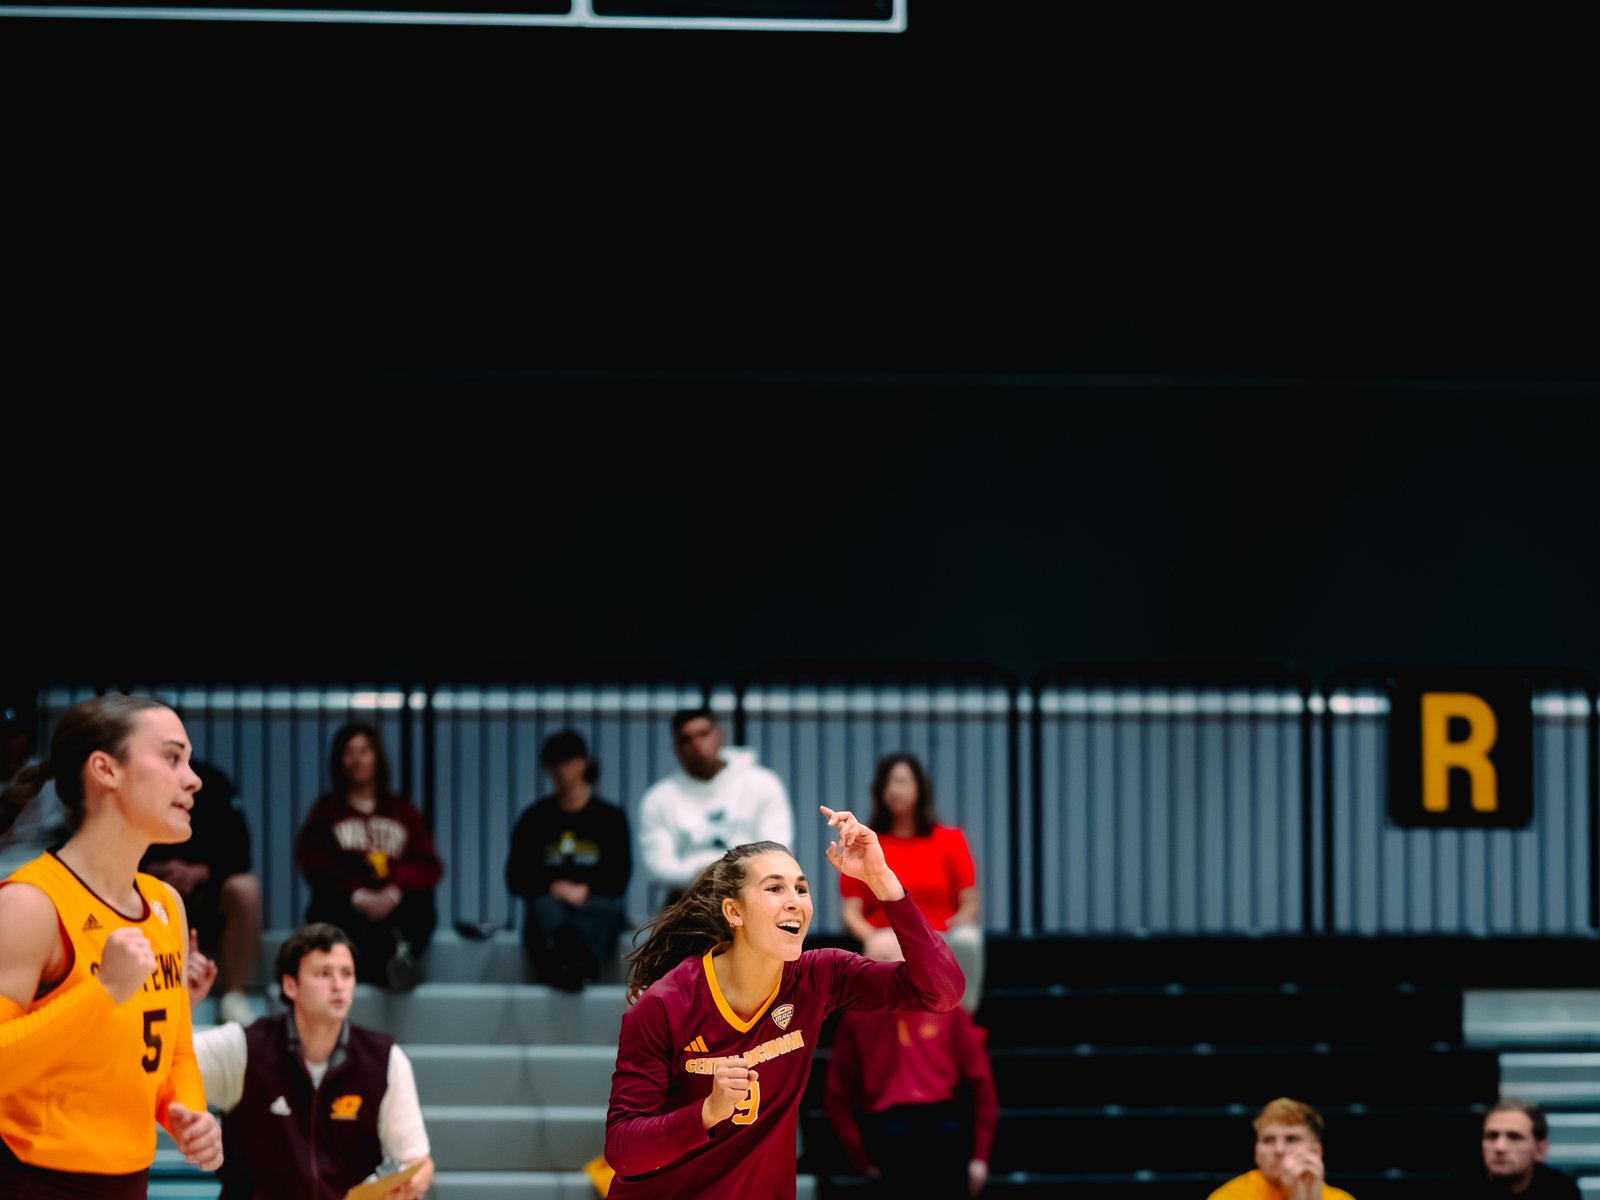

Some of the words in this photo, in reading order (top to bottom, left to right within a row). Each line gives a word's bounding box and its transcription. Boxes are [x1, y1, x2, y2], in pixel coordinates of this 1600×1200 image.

[1422, 691, 1498, 812] R
[141, 1008, 167, 1073] 5
[731, 1080, 761, 1126] 9
